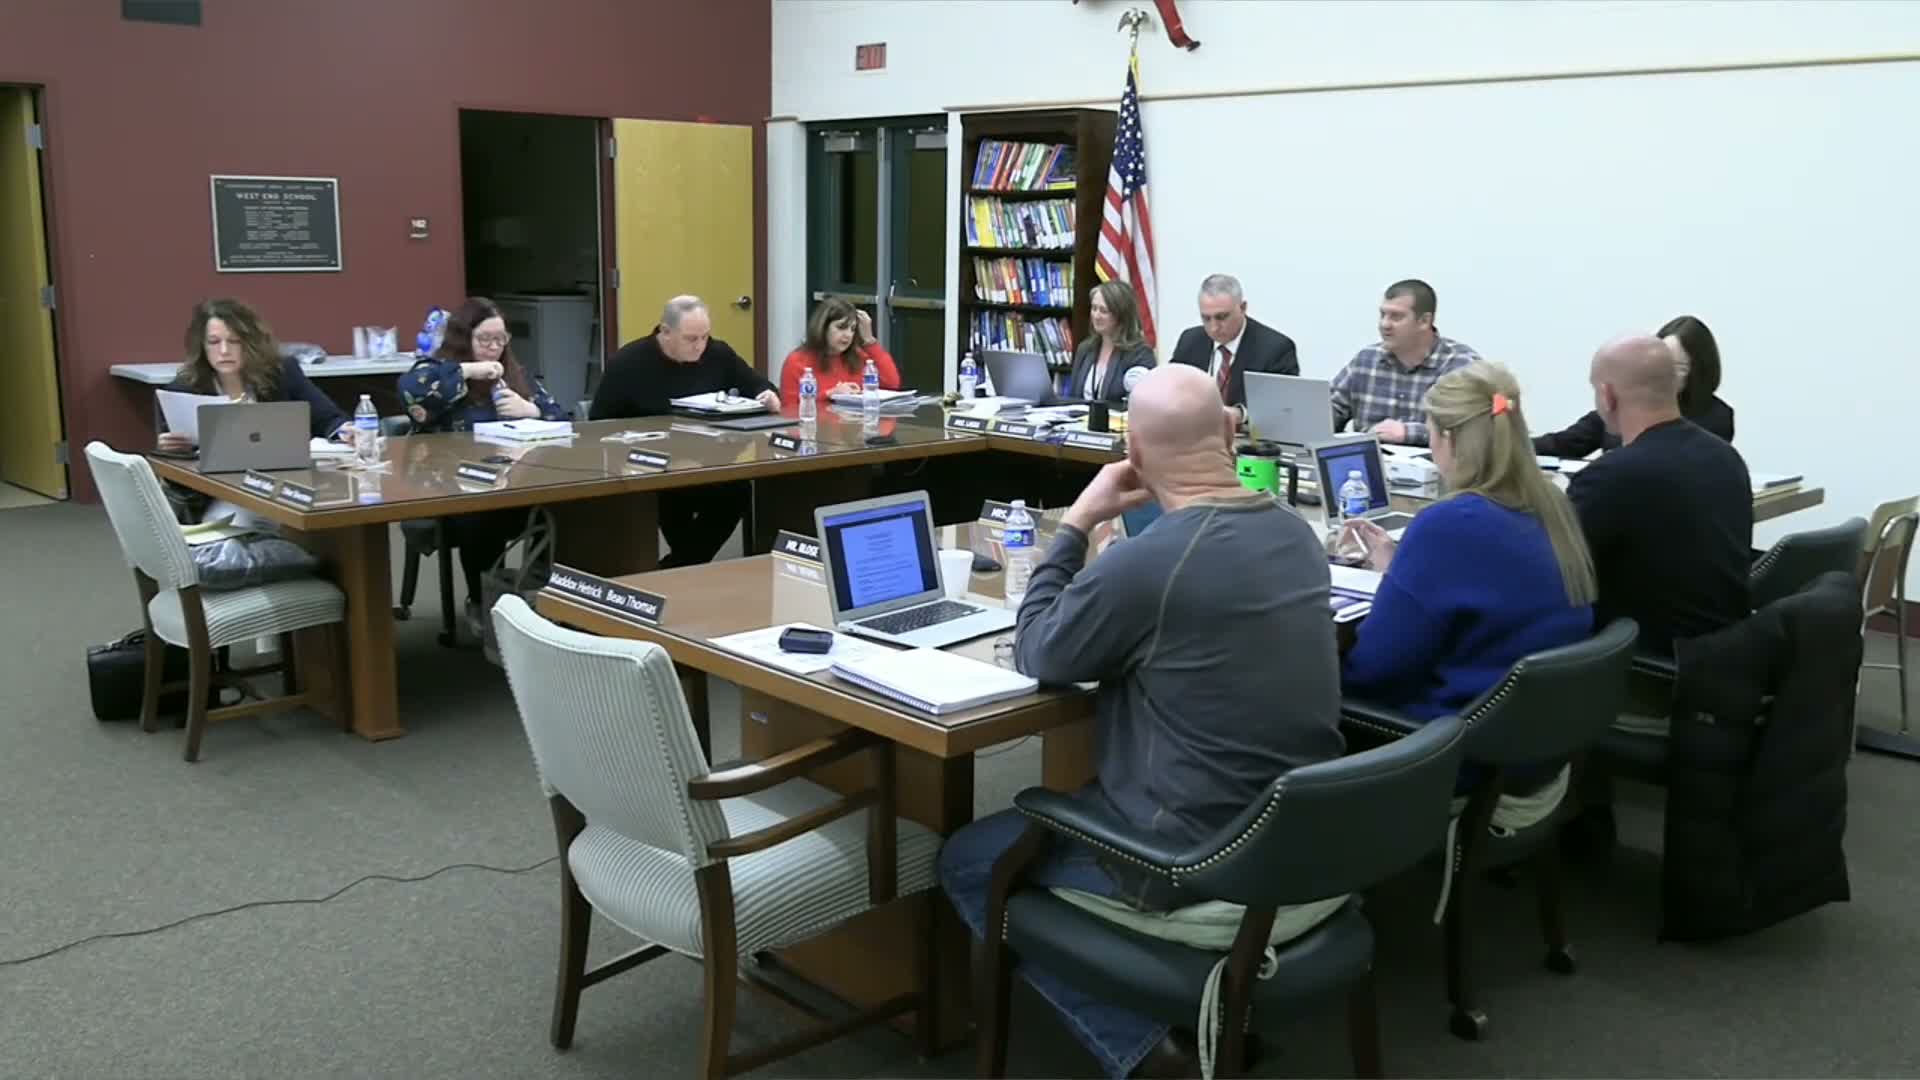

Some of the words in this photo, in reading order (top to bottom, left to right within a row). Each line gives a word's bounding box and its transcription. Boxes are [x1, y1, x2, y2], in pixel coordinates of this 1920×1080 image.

[236, 192, 259, 200] WEST
[262, 192, 280, 200] END
[283, 193, 318, 201] SCHOOL
[549, 572, 577, 590] Maddox
[576, 580, 602, 598] Hetrick
[606, 589, 627, 605] Beau
[627, 595, 657, 615] Thomas
